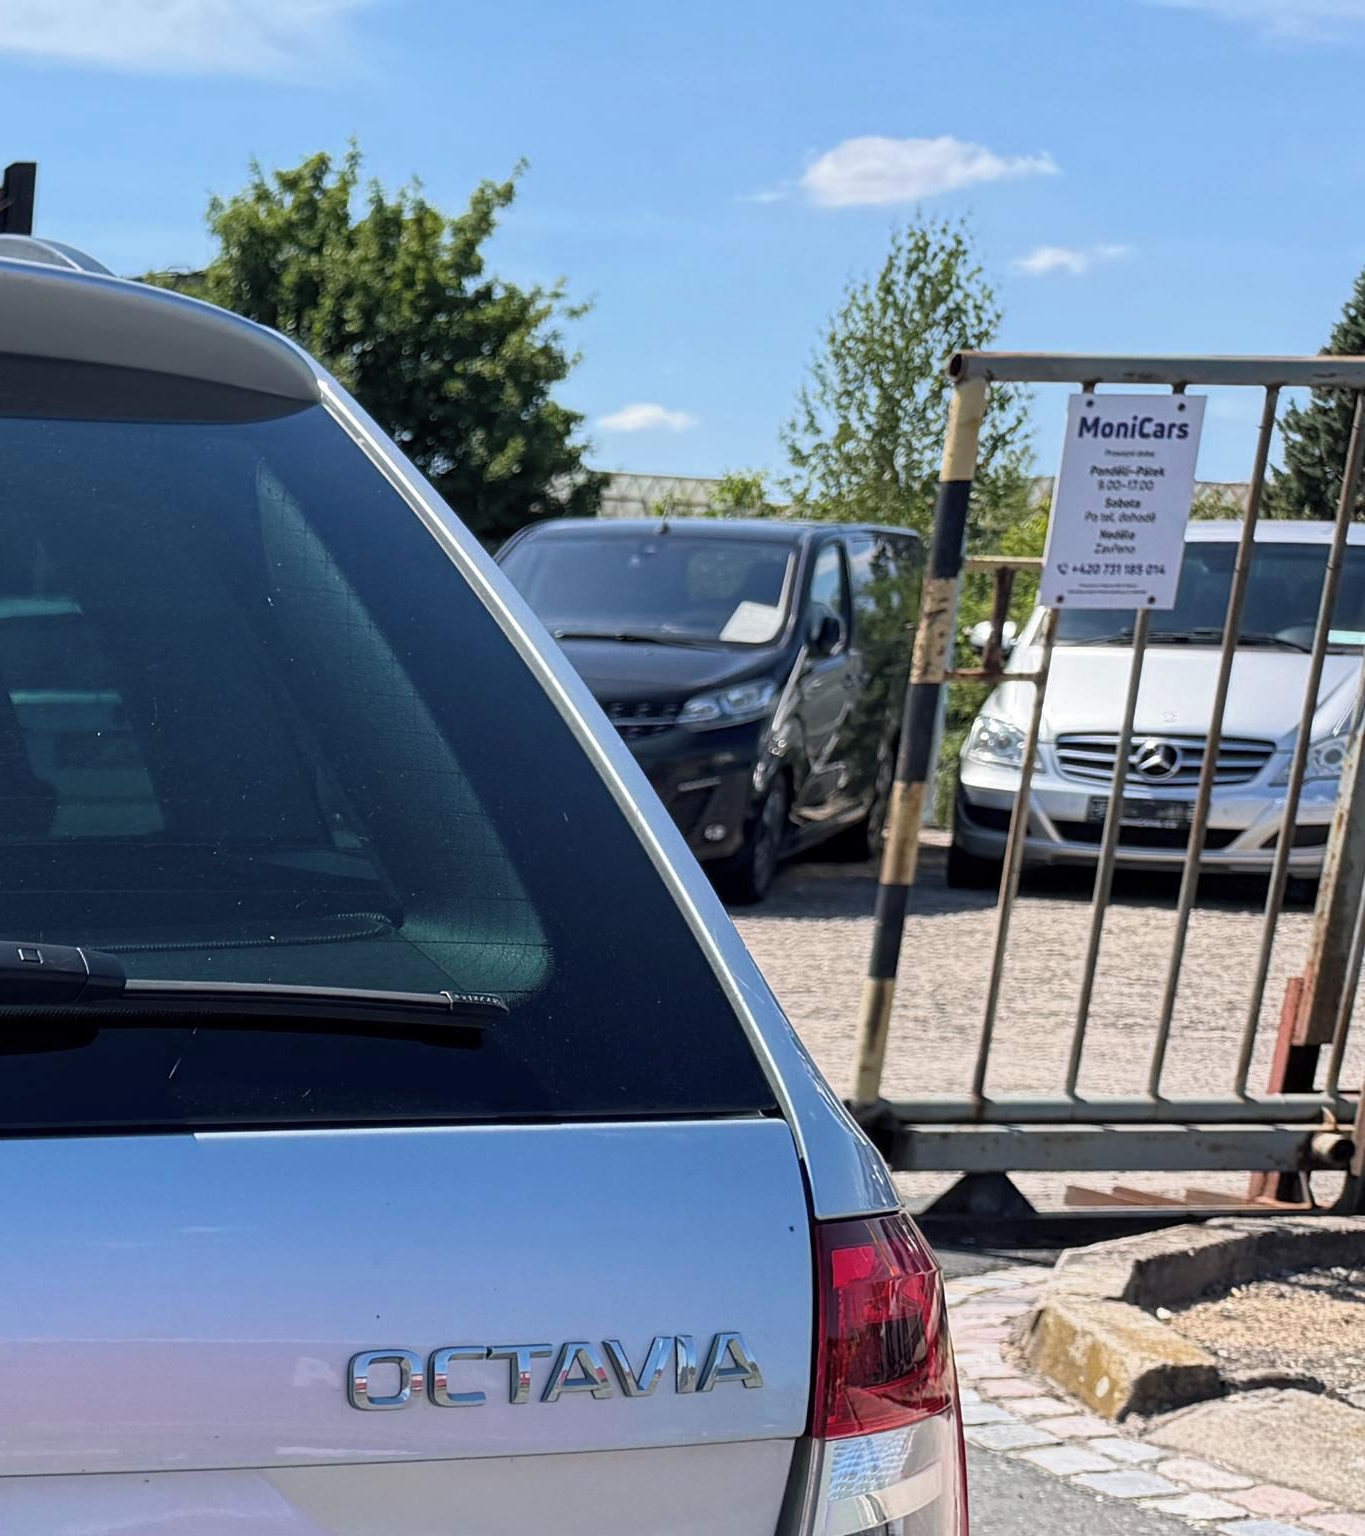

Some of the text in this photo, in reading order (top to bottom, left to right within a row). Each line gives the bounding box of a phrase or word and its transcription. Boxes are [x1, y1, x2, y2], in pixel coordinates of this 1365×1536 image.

[1078, 415, 1189, 439] MoniCars
[1104, 498, 1141, 509] Sobota
[347, 1331, 764, 1411] OCTAVIA
